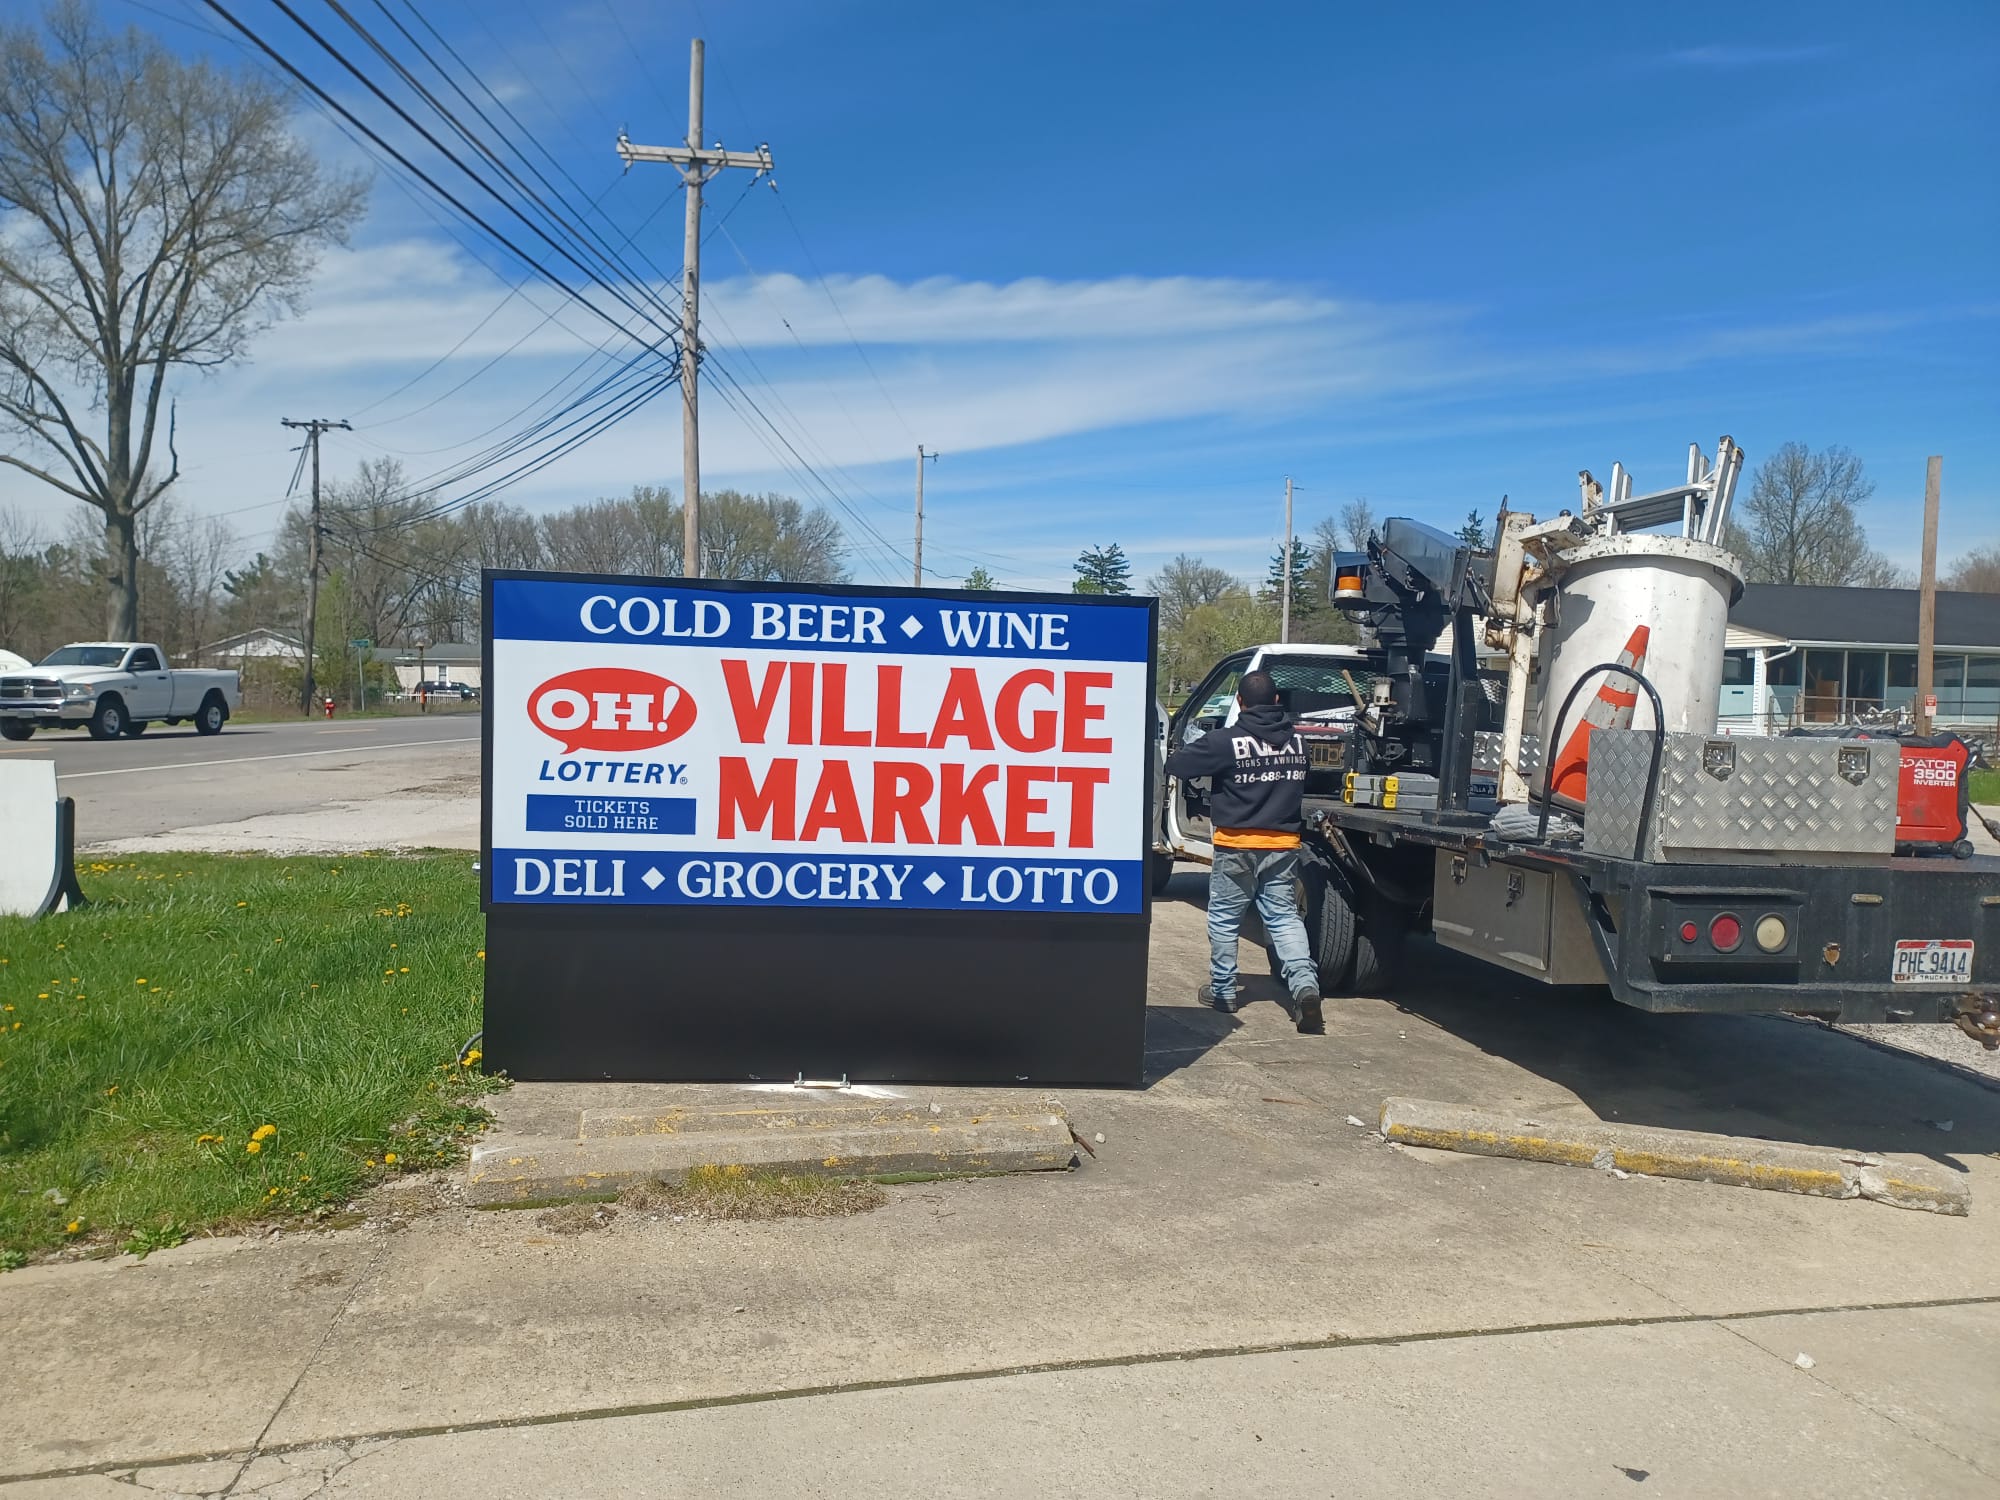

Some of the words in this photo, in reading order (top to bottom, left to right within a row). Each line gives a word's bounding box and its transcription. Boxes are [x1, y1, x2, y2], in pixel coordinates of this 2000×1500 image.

[579, 594, 731, 638] COLD
[751, 602, 887, 644] BEER
[940, 609, 1069, 651] WINE
[535, 686, 681, 733] OH!
[720, 659, 1113, 754] VILLAGE
[1235, 758, 1261, 769] SIGNS
[1265, 757, 1270, 766] &
[1273, 755, 1307, 766] AWNINGS
[1914, 768, 1956, 780] 3500
[1914, 779, 1956, 787] INVERTER
[574, 799, 650, 815] TICKETS
[716, 756, 1110, 848] MARKET
[564, 815, 608, 829] SOLD
[613, 816, 659, 830] HERE
[513, 857, 626, 898] DELI
[676, 859, 915, 902] GROCERY
[960, 865, 1119, 906] LOTTO
[1899, 951, 1927, 973] PHE
[1930, 951, 1967, 973] 9414
